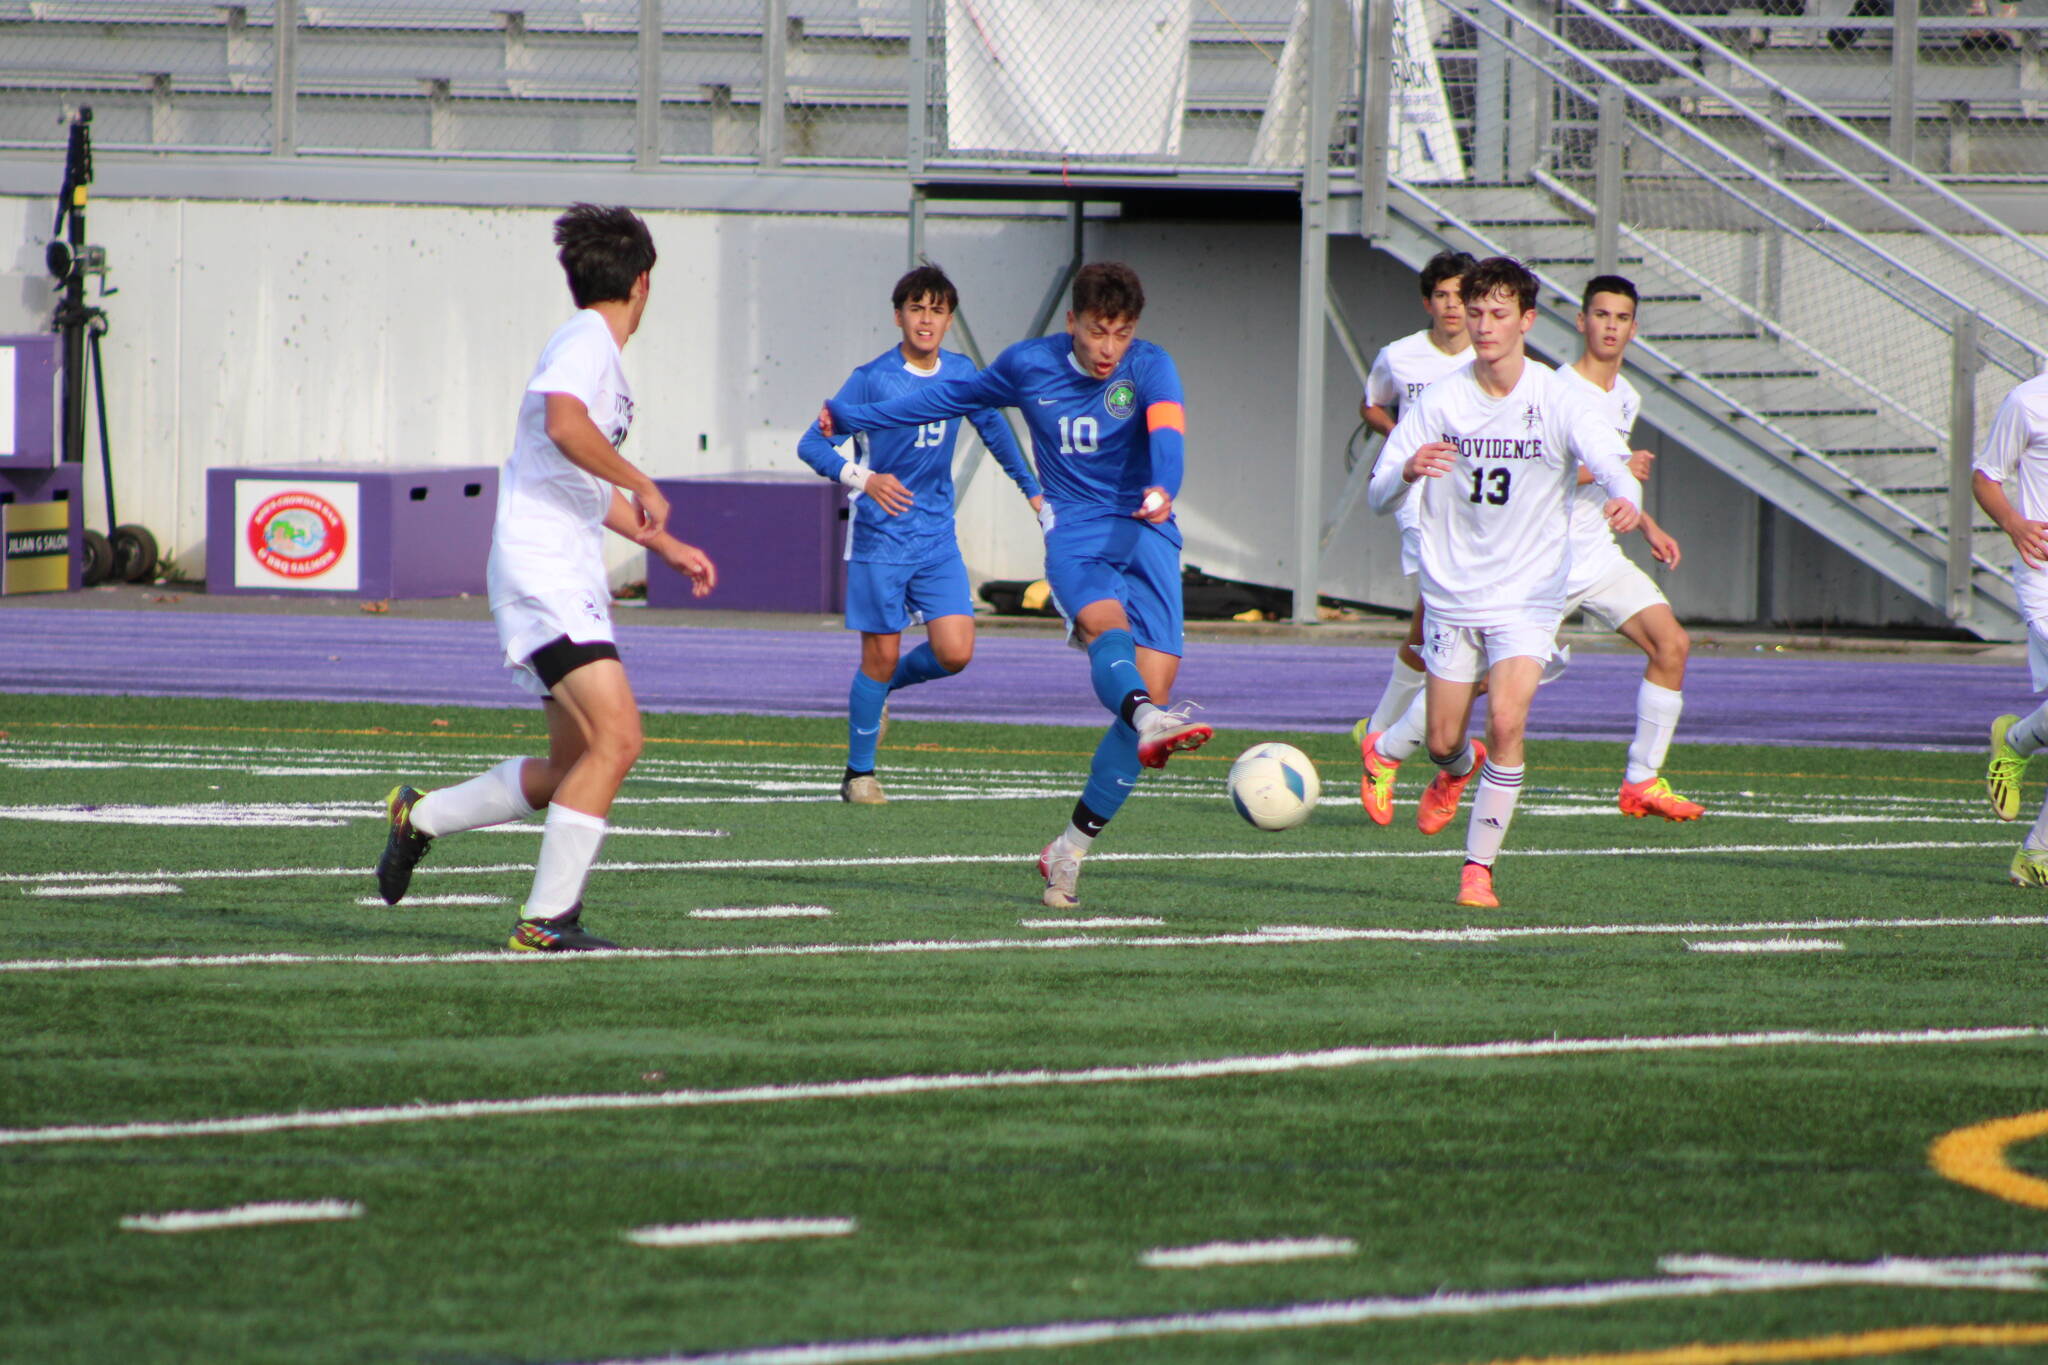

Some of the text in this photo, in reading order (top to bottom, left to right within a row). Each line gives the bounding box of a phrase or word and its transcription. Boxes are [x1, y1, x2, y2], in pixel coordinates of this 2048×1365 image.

[1391, 61, 1432, 89] RACK
[914, 419, 946, 448] 19
[1058, 416, 1098, 454] 10
[1442, 433, 1542, 460] PROVIDENCE
[1470, 467, 1512, 506] 13
